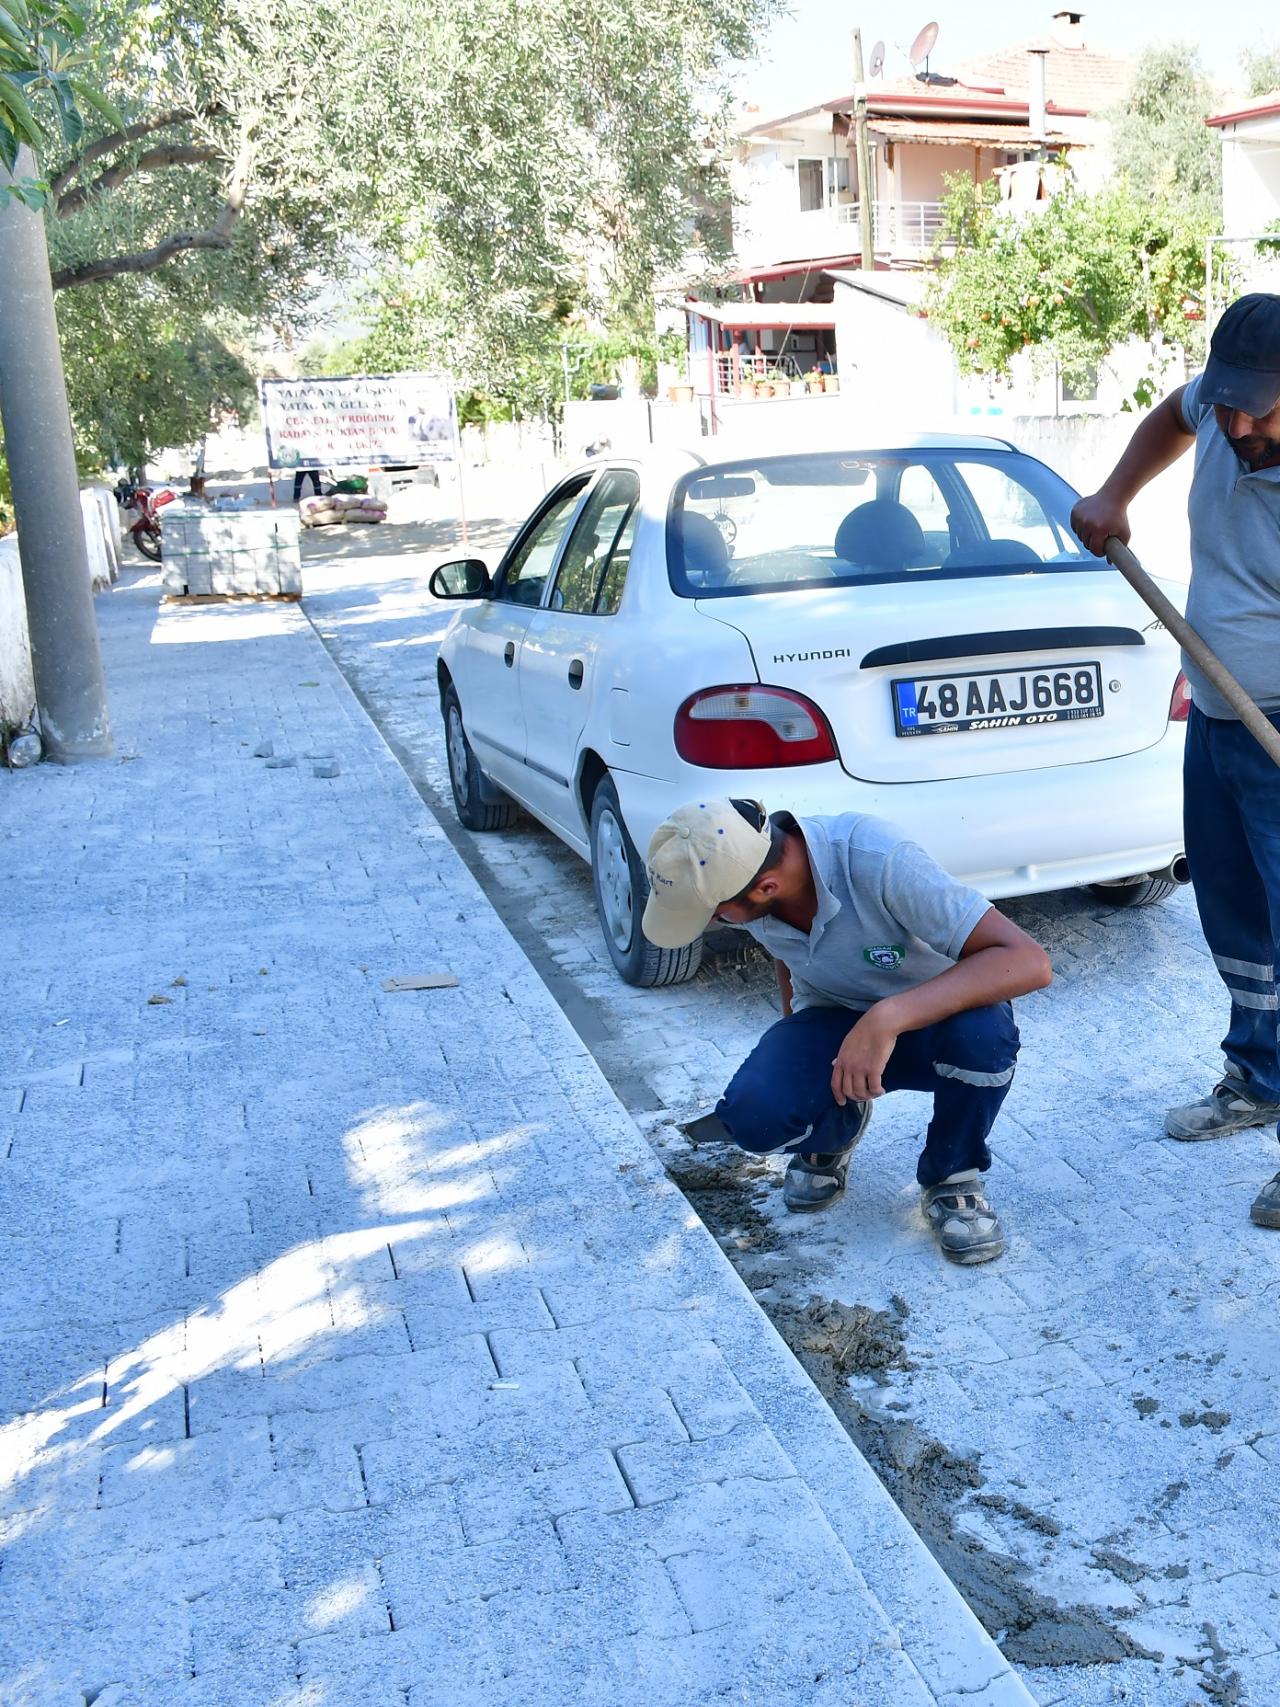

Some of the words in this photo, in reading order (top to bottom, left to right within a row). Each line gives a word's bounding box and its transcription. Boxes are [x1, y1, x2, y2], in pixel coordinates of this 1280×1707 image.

[773, 648, 851, 664] HYUNDAI
[902, 707, 917, 719] TR
[1026, 712, 1058, 724] OTO
